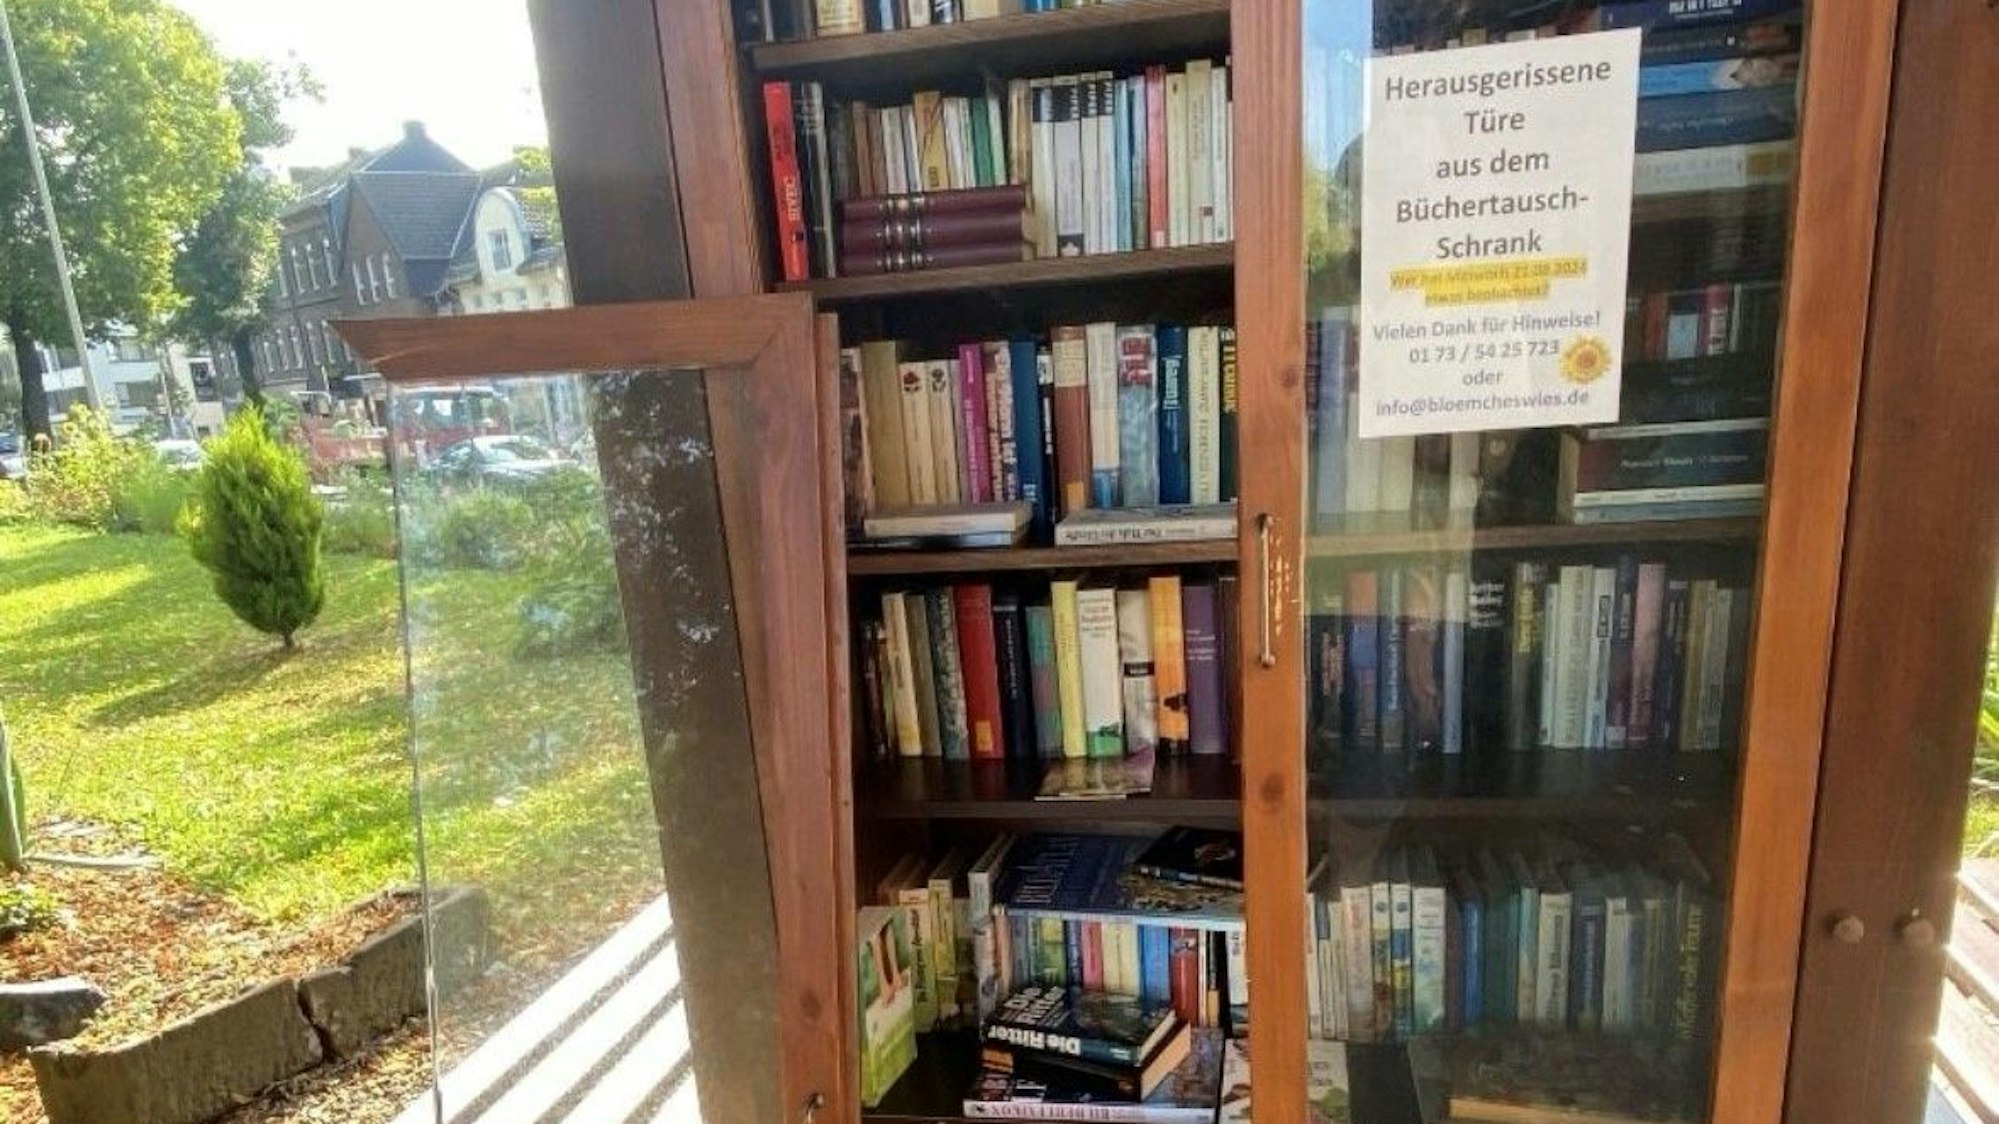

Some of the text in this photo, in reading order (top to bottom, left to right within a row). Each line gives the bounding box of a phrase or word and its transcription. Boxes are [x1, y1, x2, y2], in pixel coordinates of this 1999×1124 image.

[1385, 61, 1611, 100] Herausgerissene
[1465, 109, 1525, 134] Türe
[1436, 149, 1549, 178] aus dem
[1396, 185, 1589, 222] Büchertausch-
[1437, 228, 1542, 259] Schrank
[1373, 310, 1600, 341] Vielen Dank für Hinweise!
[1409, 339, 1560, 364] 01 73 / 54 25 723
[1462, 370, 1504, 386] oder
[1376, 391, 1589, 417] info@bloemcheswies.de
[988, 1024, 1045, 1050] Ritter
[1045, 1033, 1081, 1056] Die
